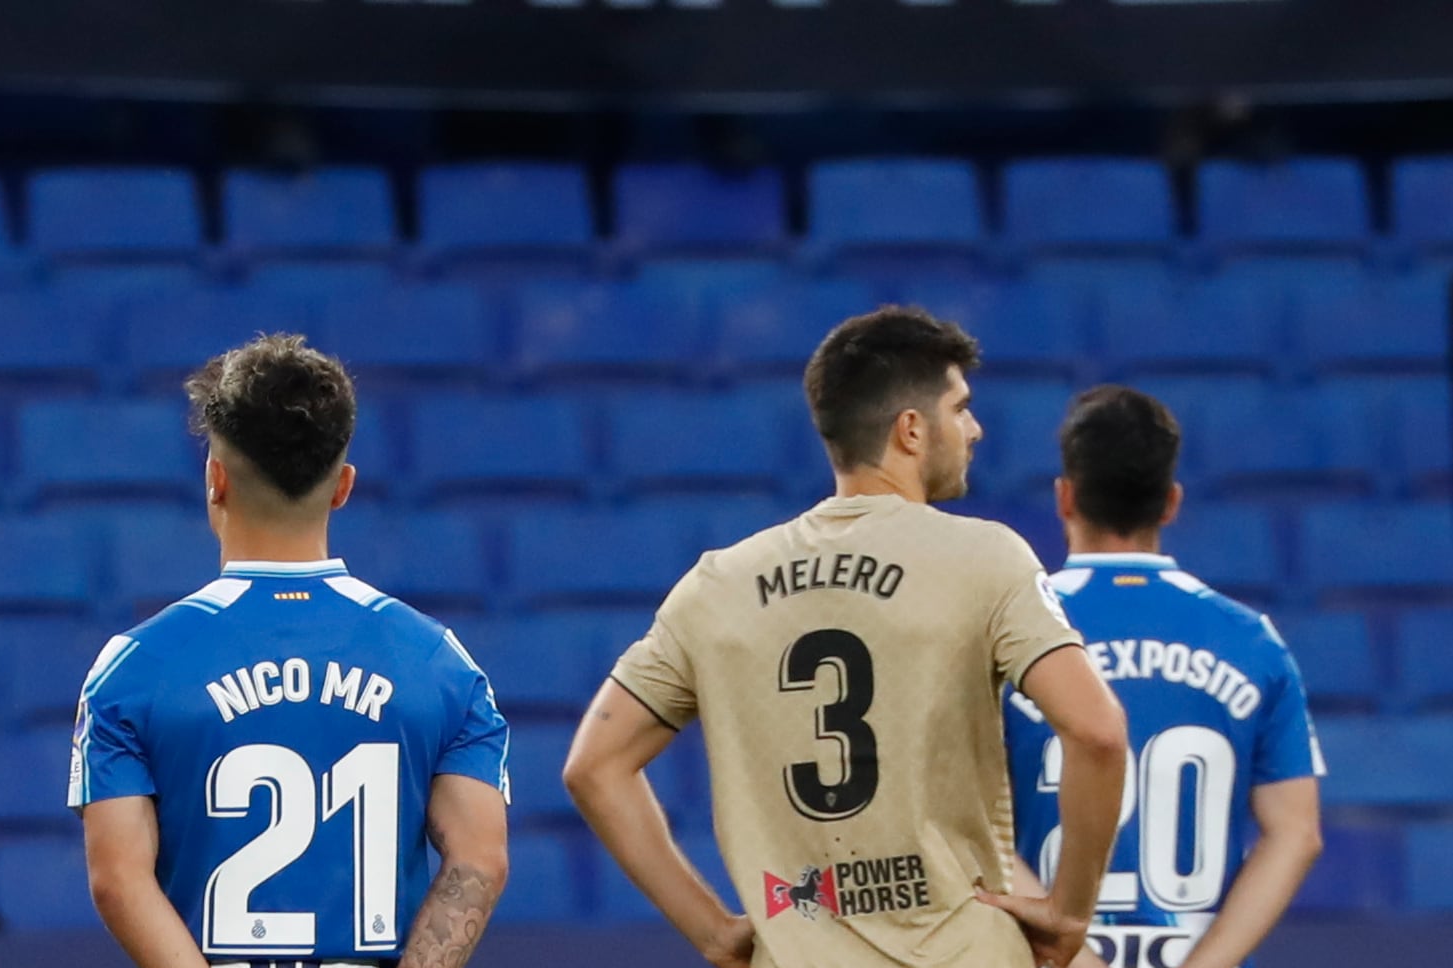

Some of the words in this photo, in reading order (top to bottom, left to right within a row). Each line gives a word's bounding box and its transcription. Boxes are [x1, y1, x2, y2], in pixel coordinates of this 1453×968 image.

[755, 553, 905, 608] MELERO
[205, 657, 311, 723] NICO
[319, 661, 394, 722] MR
[777, 628, 880, 823] 3
[202, 742, 399, 955] 21
[835, 854, 925, 889] POWER
[840, 880, 930, 916] HORSE
